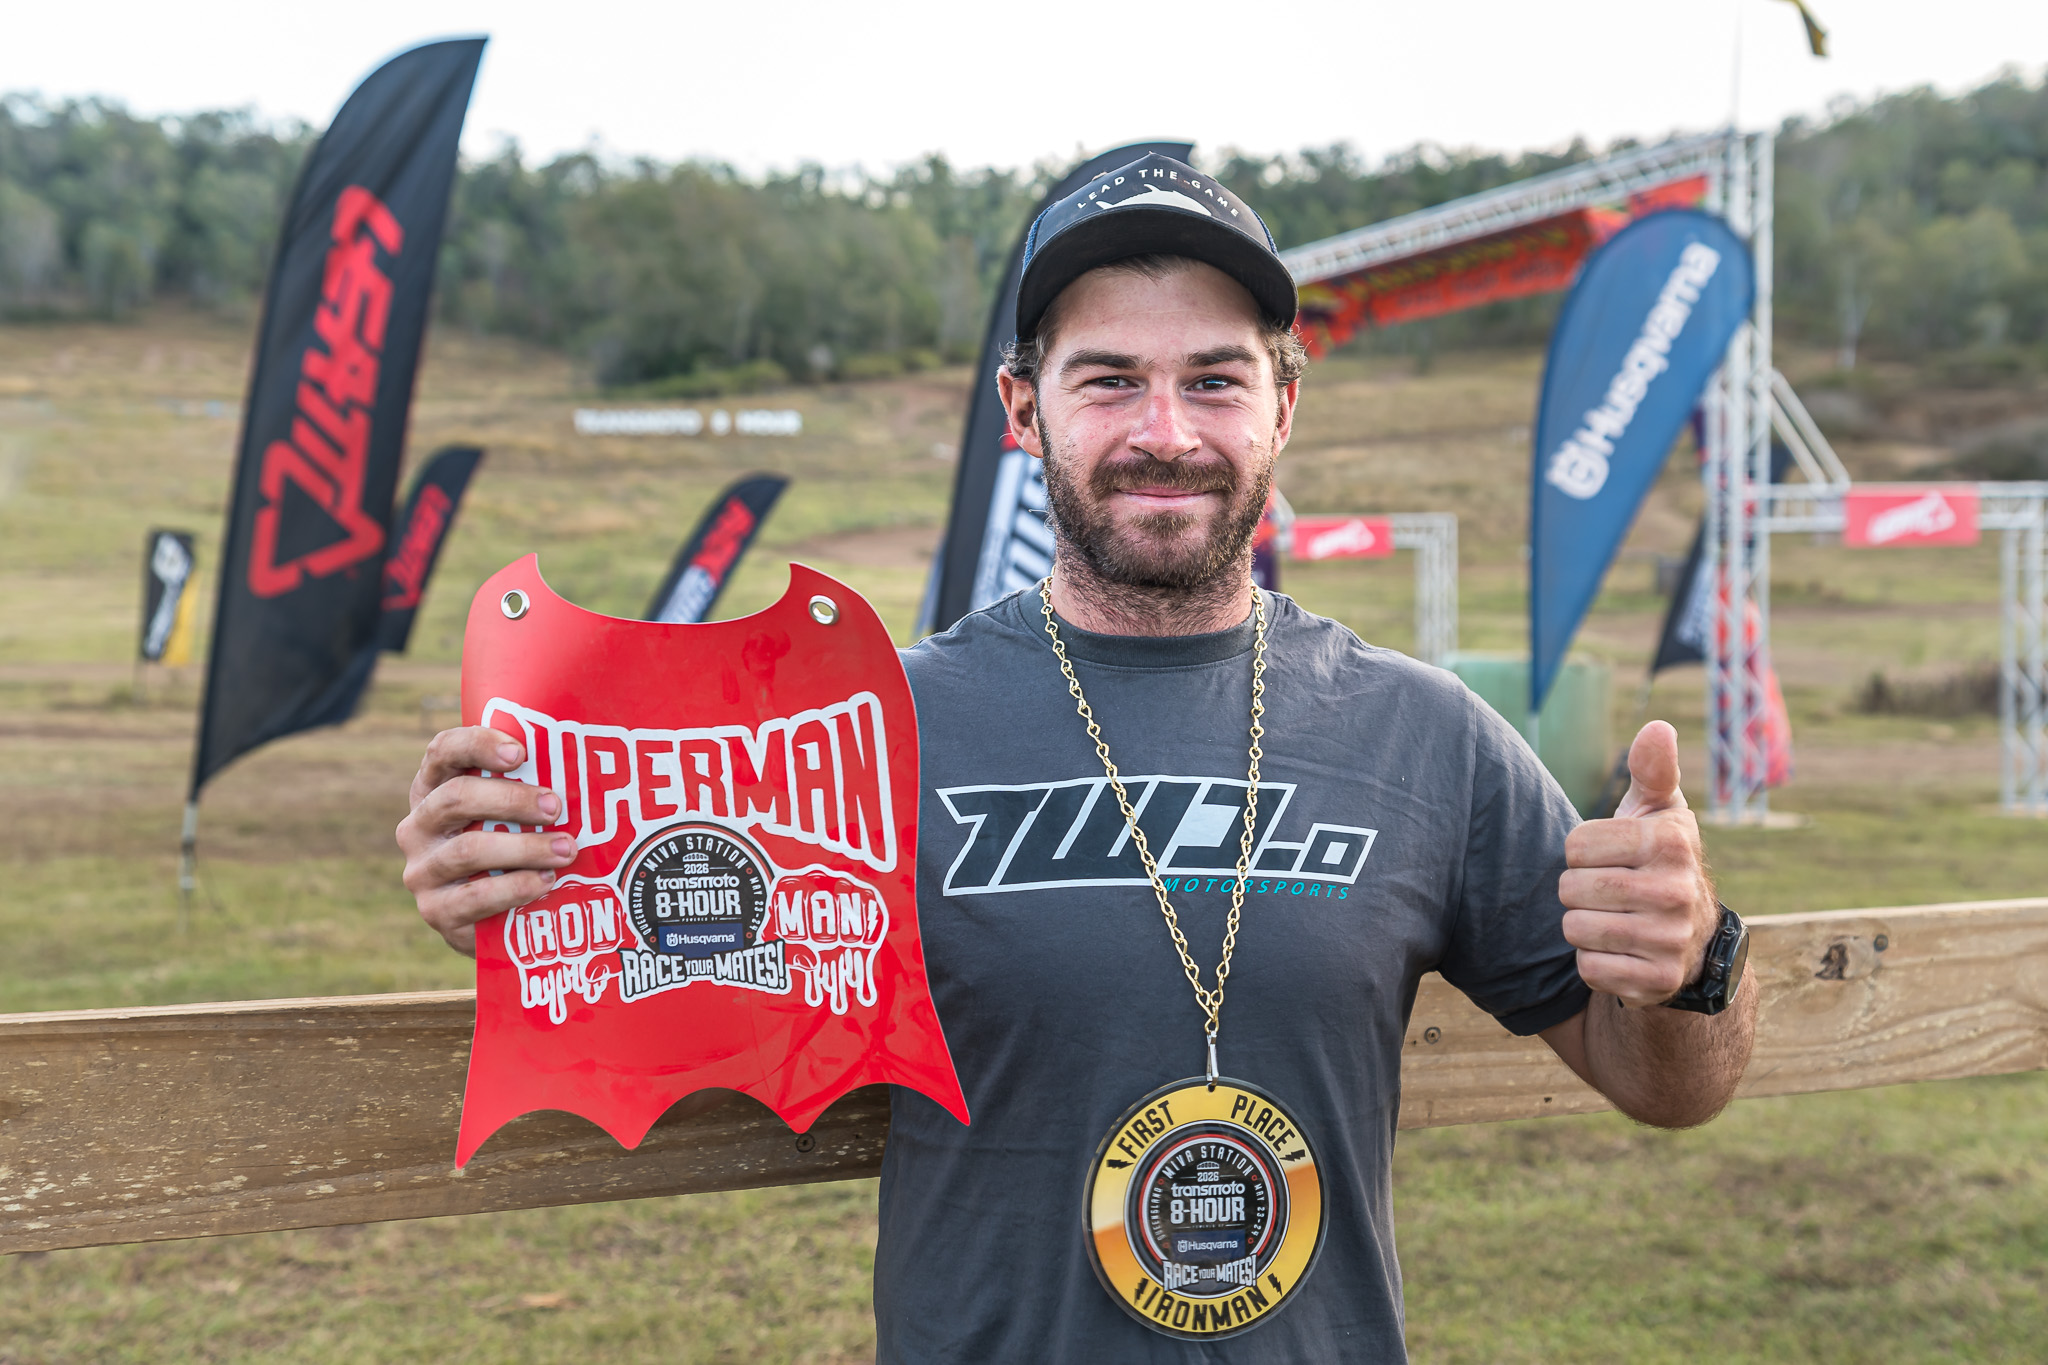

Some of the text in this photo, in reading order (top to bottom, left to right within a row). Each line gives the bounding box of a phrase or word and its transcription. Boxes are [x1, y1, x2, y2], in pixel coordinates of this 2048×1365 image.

[1077, 168, 1239, 217] LEAD THE GAME
[1573, 241, 1722, 458] Husqvarna
[643, 836, 748, 872] MIVA STATION
[683, 863, 709, 875] 2026
[654, 873, 740, 891] transmoto
[1163, 876, 1350, 900] MOTORSPORTS
[632, 880, 653, 936] QUEENSLAND
[655, 889, 742, 918] 8-HOUR
[749, 876, 764, 931] MAY 23-24
[776, 890, 863, 937] MAN
[514, 897, 617, 959] IRON
[678, 933, 735, 945] Husqvarna
[620, 940, 788, 997] RACE YOUR MATES!
[1116, 1094, 1296, 1160] FIRST PLACE
[1162, 1145, 1254, 1179] MIVA STATION
[1197, 1171, 1219, 1182] 2026
[1170, 1181, 1246, 1197] transmoto
[1254, 1183, 1265, 1201] MAY
[1150, 1187, 1167, 1241] QUEENSLAND
[1170, 1196, 1246, 1225] 8-HOUR
[1188, 1240, 1238, 1252] Husqvarna
[1163, 1254, 1257, 1292] RACE YOUR MATES!
[1142, 1286, 1270, 1331] IRONMAN
